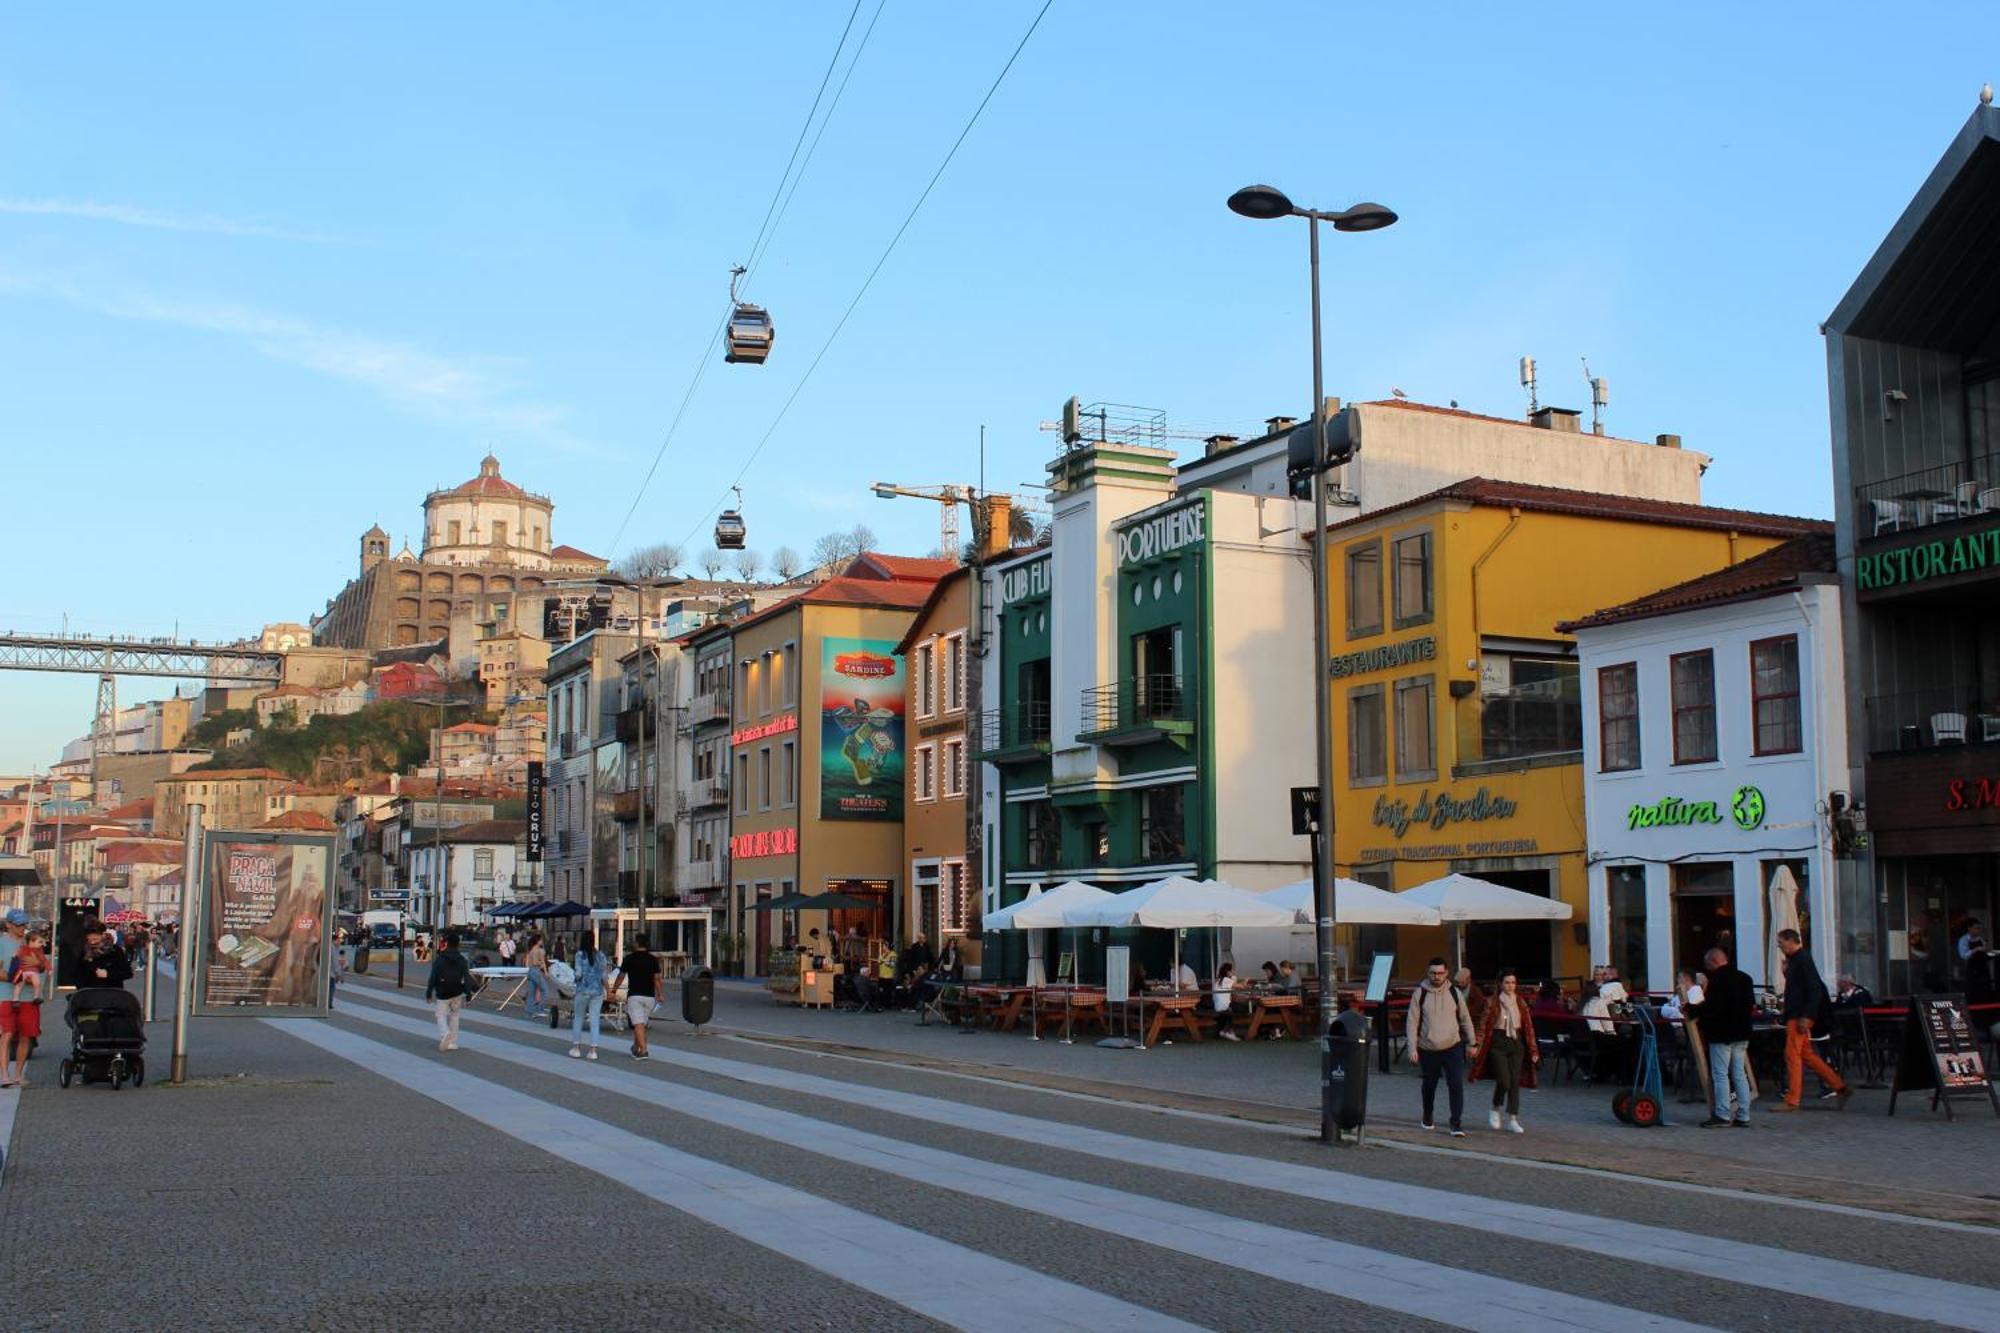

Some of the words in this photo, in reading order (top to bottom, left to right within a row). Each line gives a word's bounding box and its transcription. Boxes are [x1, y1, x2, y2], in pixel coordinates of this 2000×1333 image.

[1118, 502, 1205, 567] PORTUENSE
[1003, 568, 1028, 604] CLUB
[1330, 637, 1436, 679] ESTAURANTE
[531, 770, 540, 809] ORTO
[530, 812, 540, 853] CRUZ
[1628, 797, 1723, 830] natura
[66, 898, 95, 907] GAIA
